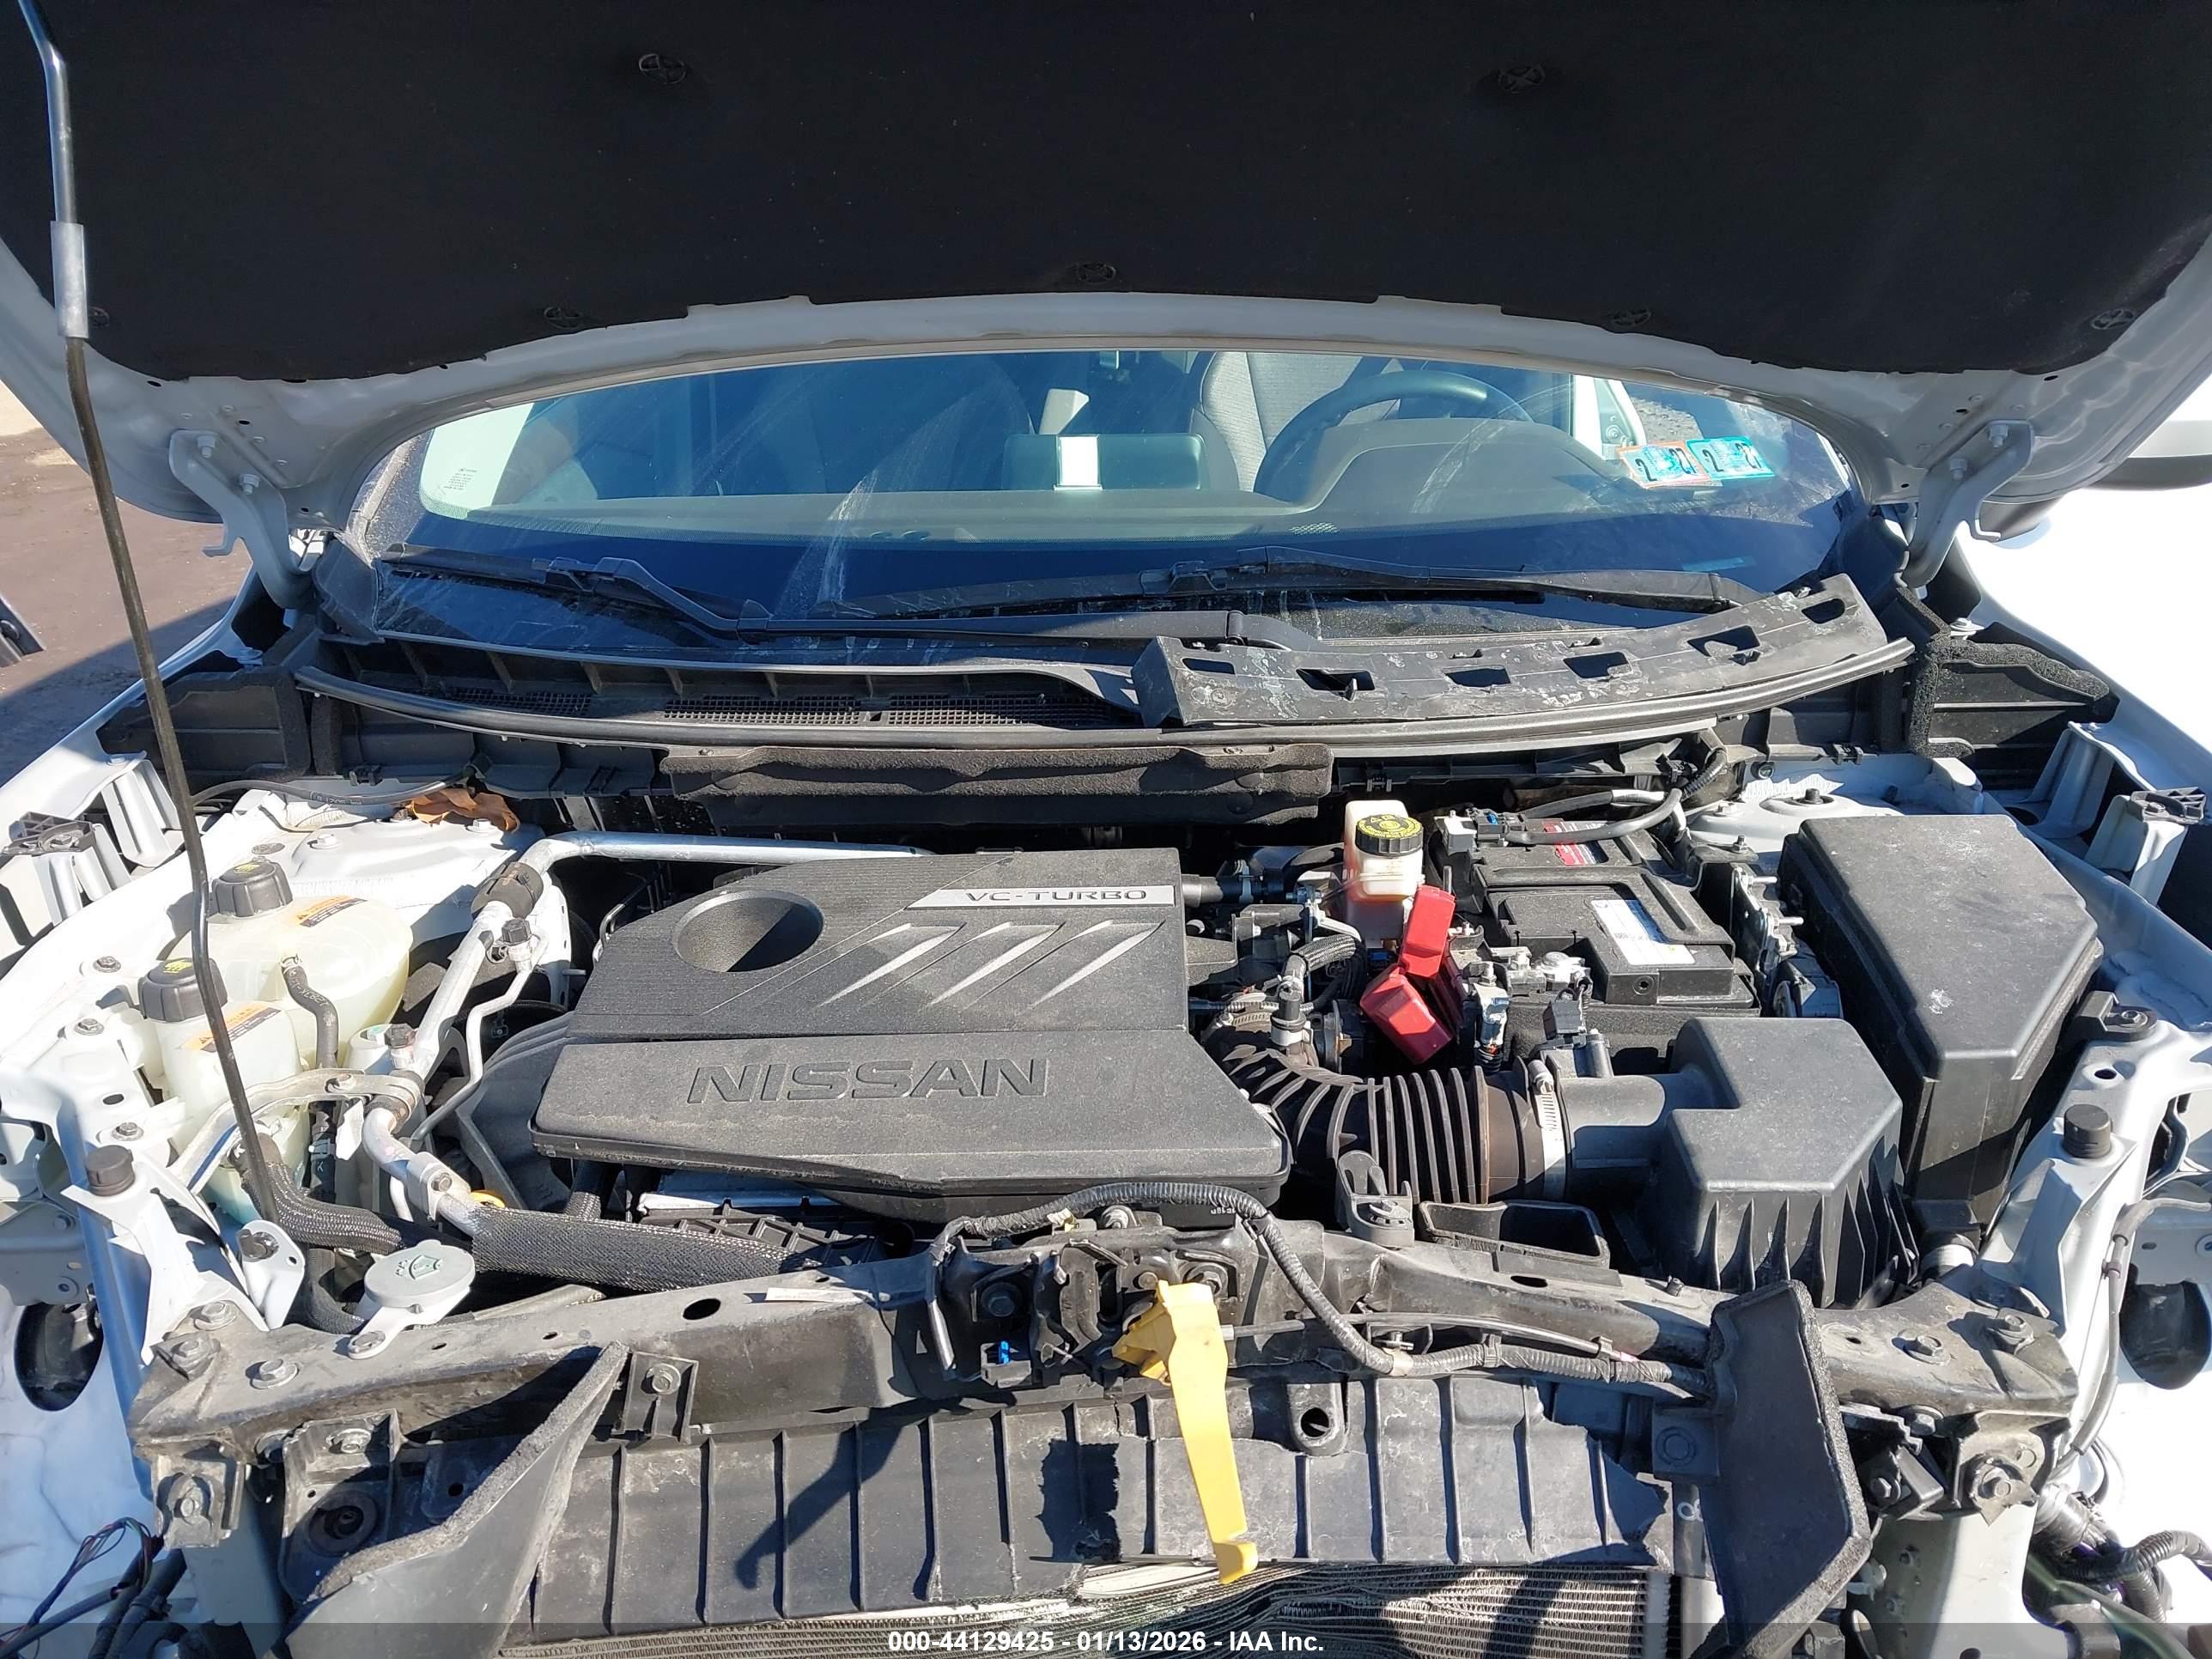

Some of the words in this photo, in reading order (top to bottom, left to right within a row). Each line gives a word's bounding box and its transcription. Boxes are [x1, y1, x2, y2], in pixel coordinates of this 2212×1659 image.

[1635, 458, 1657, 482] 2
[1702, 449, 1723, 472] 2
[965, 890, 1147, 902] VC-TURBO
[686, 1058, 1048, 1104] NISSAN
